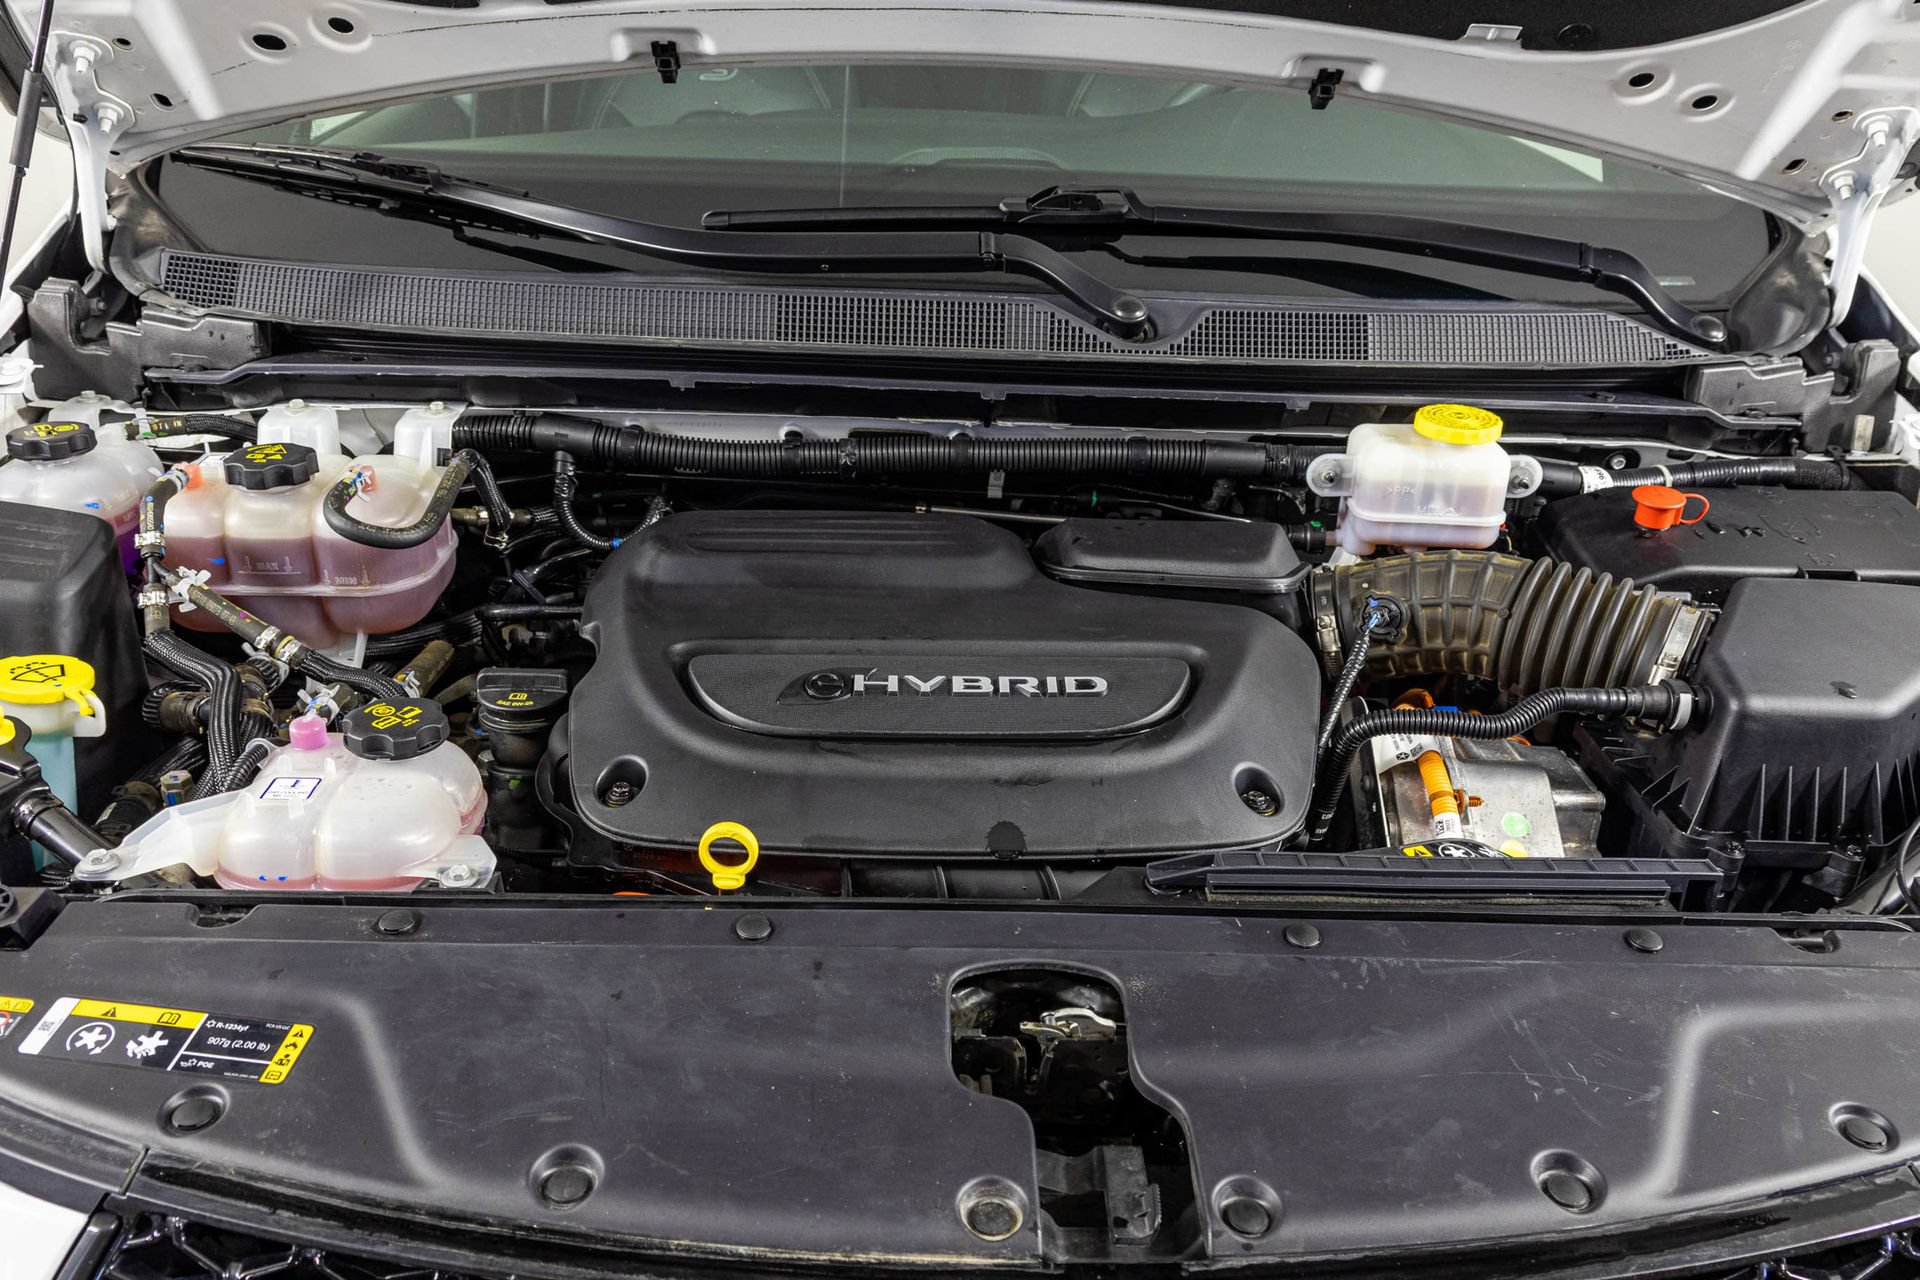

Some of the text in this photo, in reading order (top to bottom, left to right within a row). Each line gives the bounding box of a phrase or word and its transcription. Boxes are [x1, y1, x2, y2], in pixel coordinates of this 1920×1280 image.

[215, 1023, 250, 1032] R-1234yf
[207, 1036, 271, 1052] 907g (2.00 lb)
[196, 1060, 215, 1069] POE
